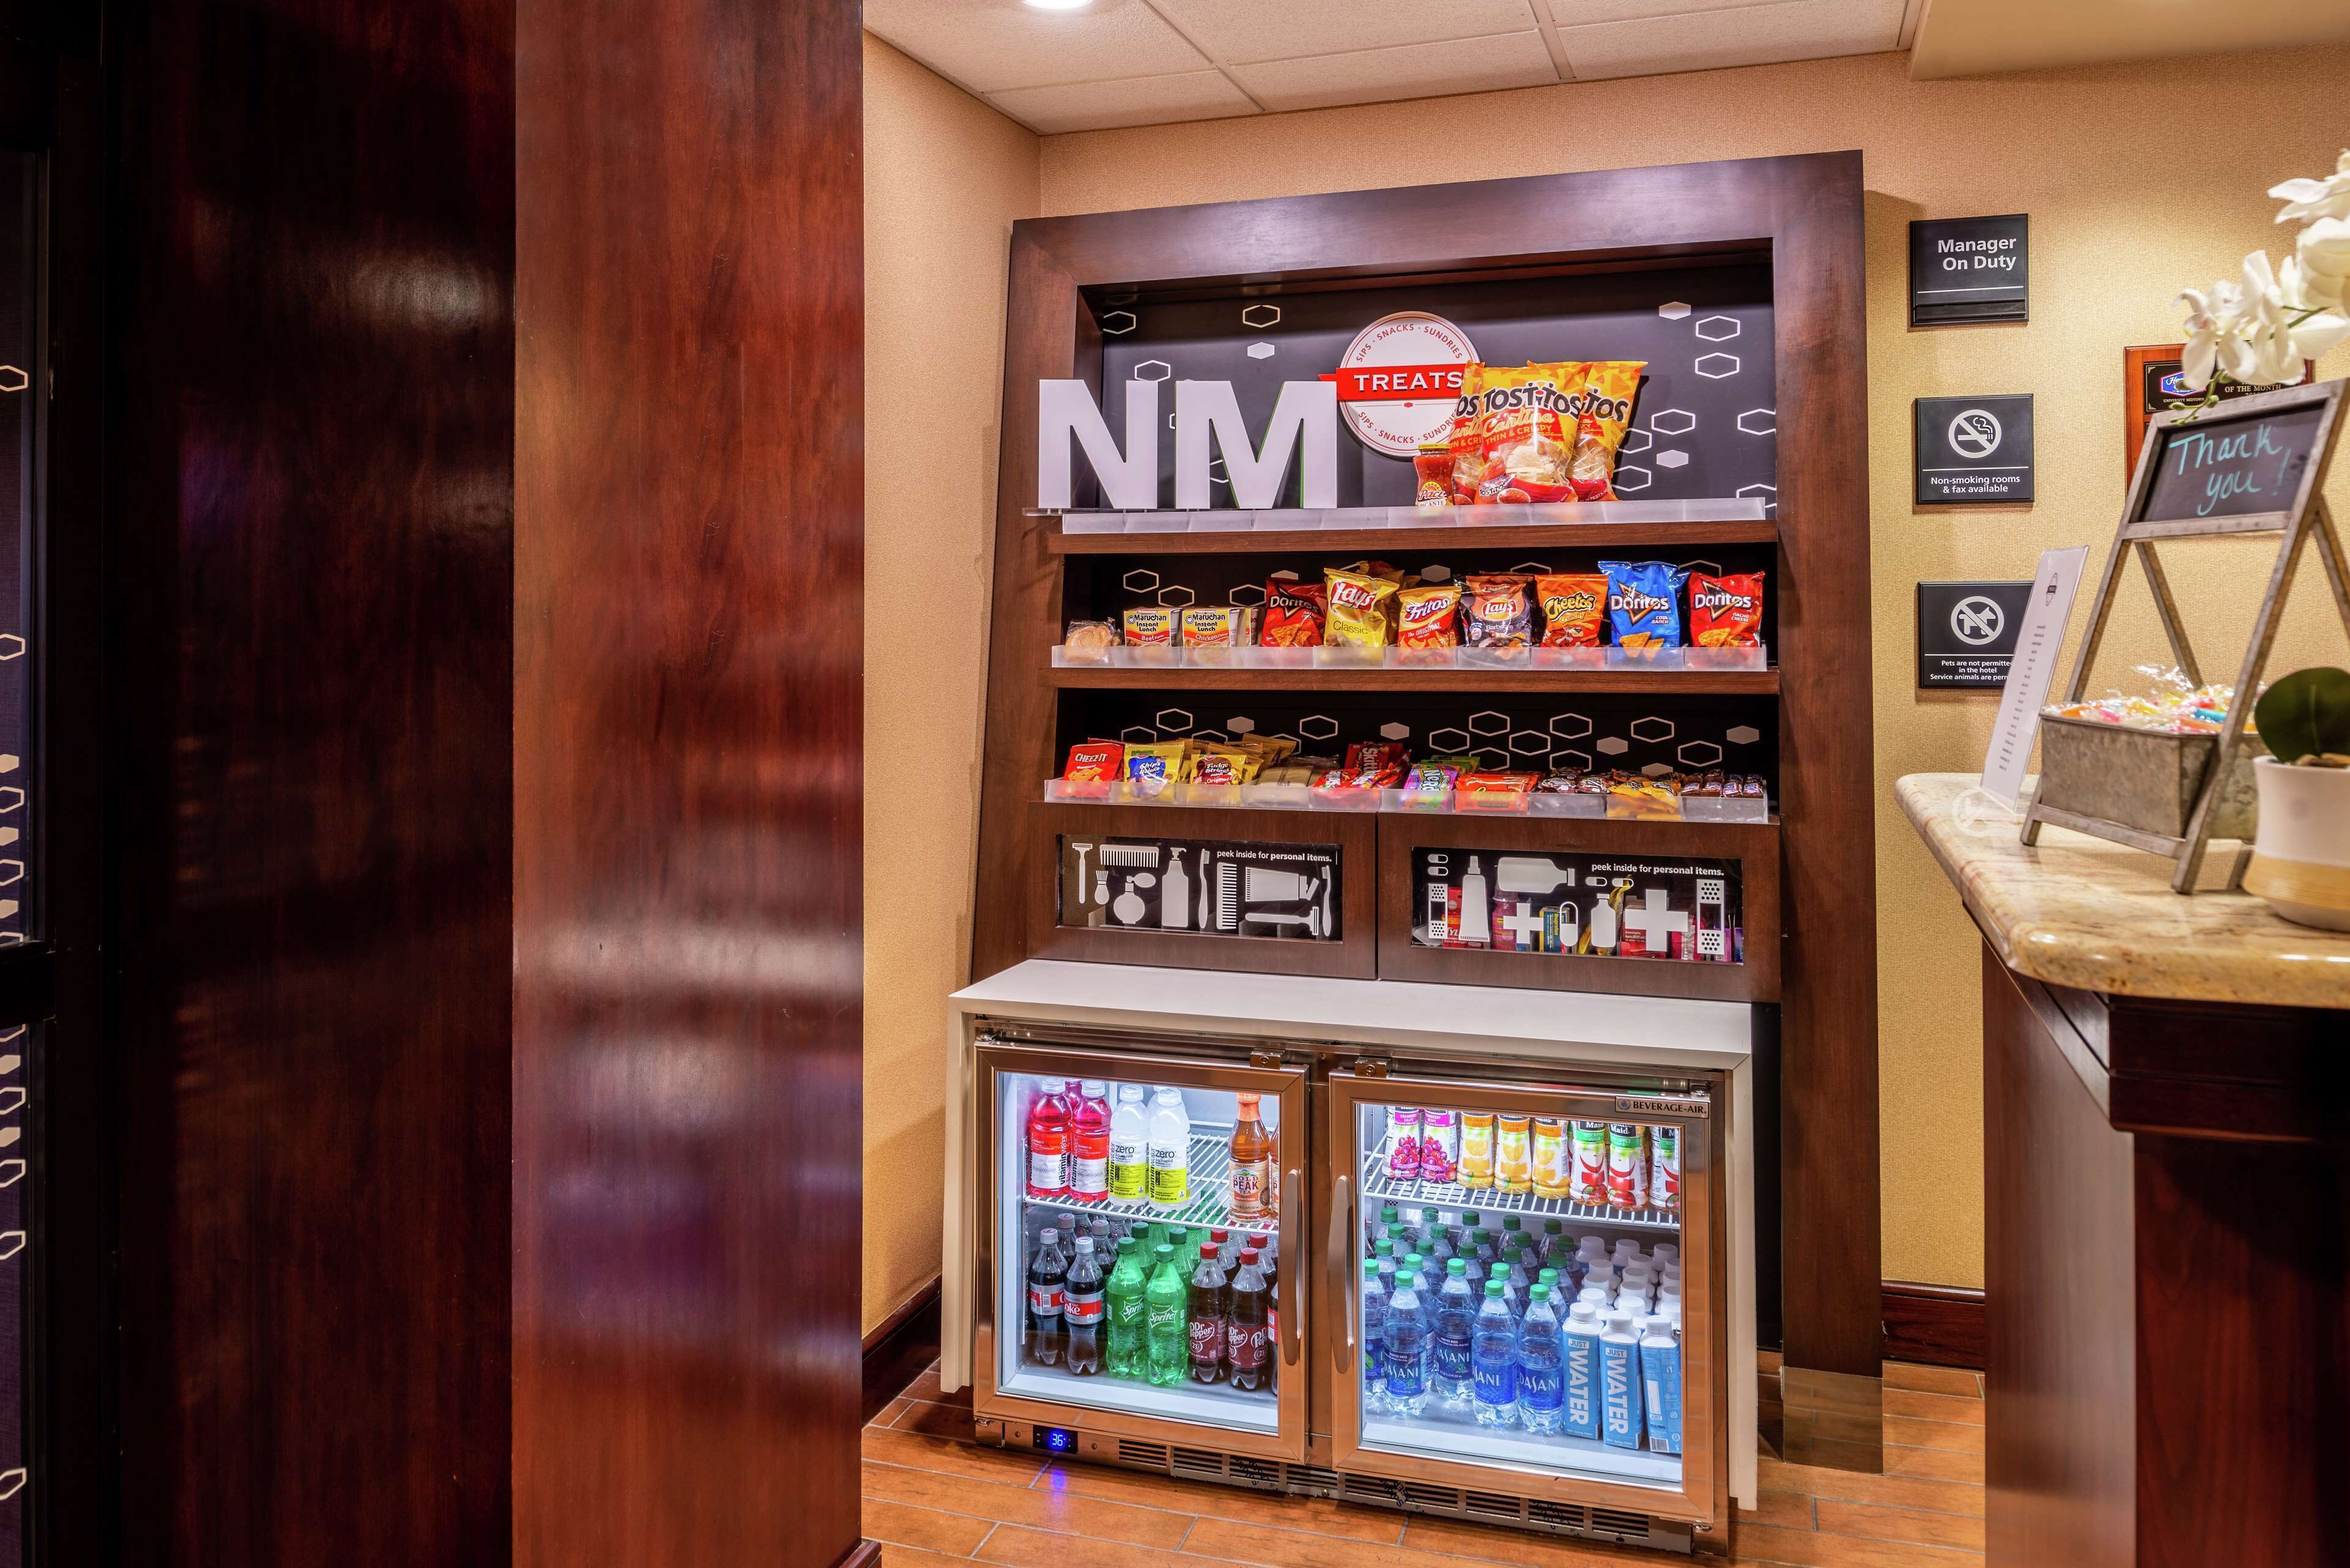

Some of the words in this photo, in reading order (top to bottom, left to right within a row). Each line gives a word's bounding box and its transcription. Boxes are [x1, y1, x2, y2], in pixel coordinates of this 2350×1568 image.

[1938, 237, 2016, 253] Manager
[1943, 257, 1968, 271] On
[1974, 255, 2016, 271] Duty
[1356, 343, 1372, 362] SIPS
[1377, 324, 1414, 340] SNACKS
[1424, 326, 1462, 359] SUNDRIES
[1353, 371, 1464, 392] TREATS
[1358, 411, 1374, 428] SIPS
[1379, 430, 1414, 443] SNACKS
[1423, 408, 1457, 441] SUNDRIE
[1486, 431, 1506, 445] THIN
[2168, 424, 2283, 475] Thank
[1931, 476, 1989, 485] Non-smoking
[1968, 484, 2008, 493] available
[1270, 595, 1319, 613] Doritos
[1544, 592, 1595, 619] Cheetos
[1611, 594, 1670, 611] Doritos
[1694, 593, 1752, 609] Doritos
[1405, 598, 1450, 622] Fritos
[1333, 621, 1368, 635] Classic
[1258, 851, 1269, 859] for
[1592, 863, 1612, 872] peek
[1613, 864, 1637, 872] inside
[1639, 864, 1652, 873] for
[1653, 866, 1693, 875] personal
[1695, 867, 1724, 876] items.
[1633, 1101, 1704, 1114] BEVERAGE-AIR
[1115, 1145, 1135, 1154] zero
[1155, 1149, 1175, 1159] zero
[1233, 1180, 1259, 1190] PEAK
[1065, 1302, 1080, 1315] oke
[1123, 1302, 1144, 1316] Sprit
[1150, 1312, 1175, 1323] Sprite
[1194, 1322, 1205, 1331] Dr
[1229, 1334, 1245, 1344] epper
[1570, 1339, 1587, 1348] JUST
[1474, 1365, 1499, 1386] SANI
[1519, 1372, 1559, 1394] DASANI
[1570, 1350, 1589, 1425] WATER
[1606, 1357, 1629, 1434] WATER
[1052, 1433, 1063, 1447] 36
